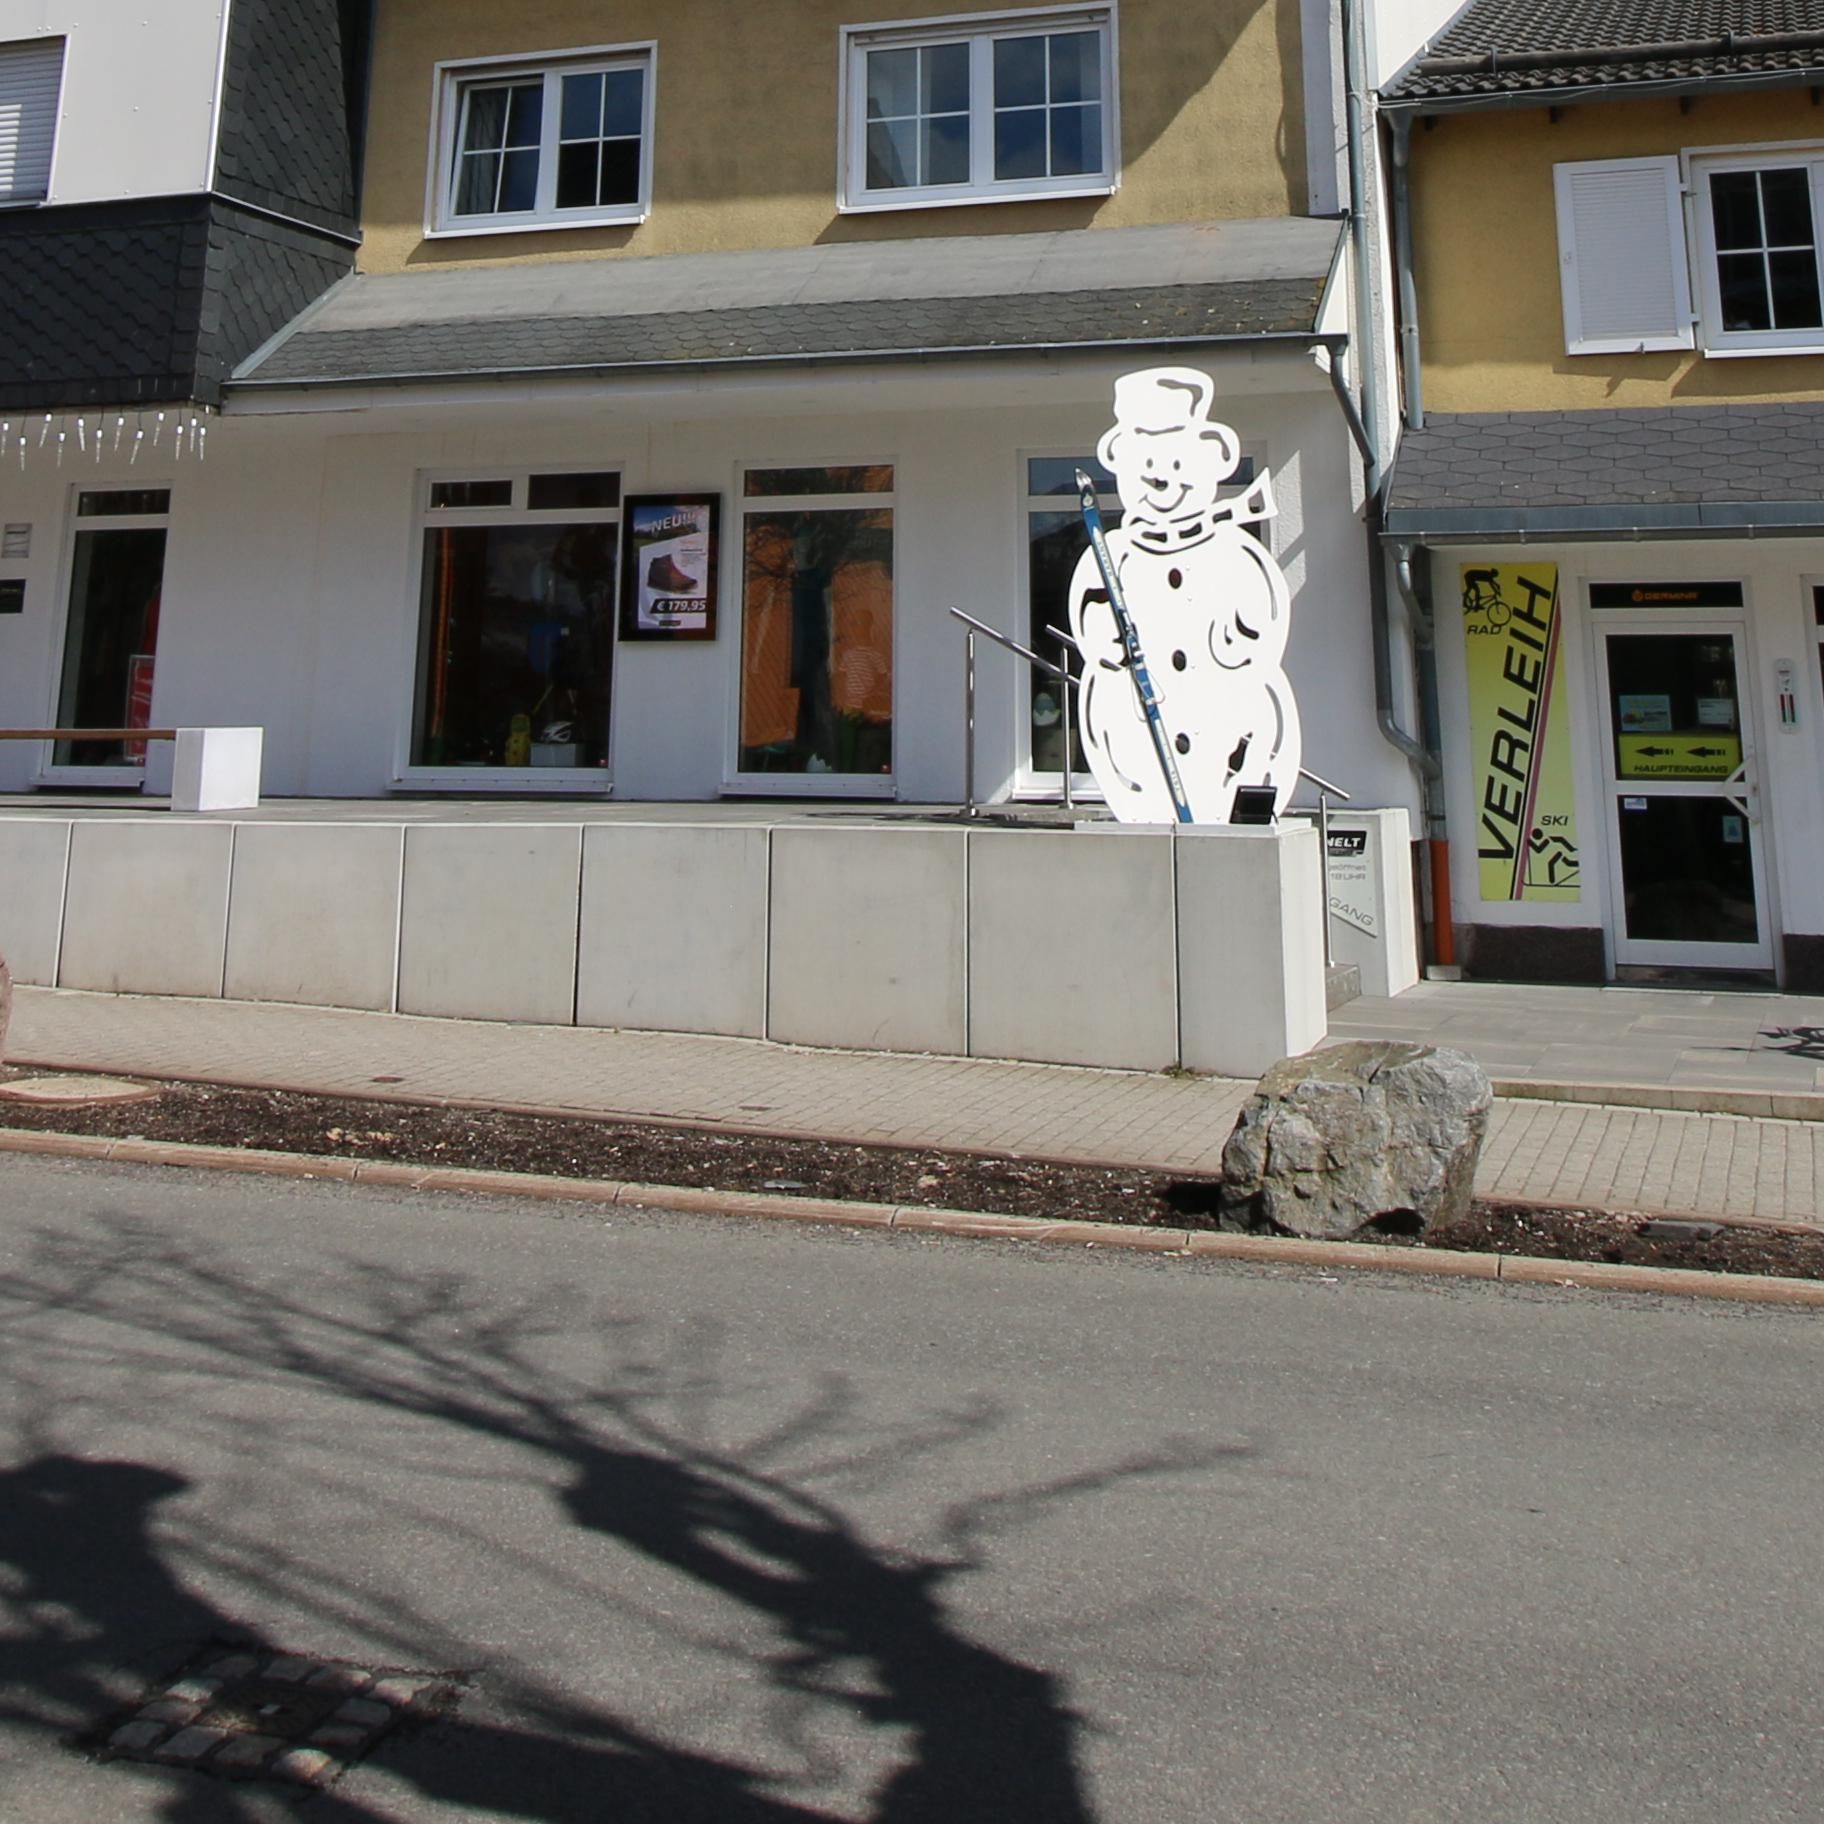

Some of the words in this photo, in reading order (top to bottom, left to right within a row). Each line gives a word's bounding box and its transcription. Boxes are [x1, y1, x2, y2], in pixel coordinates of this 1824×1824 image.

[1467, 624, 1502, 636] RAD
[1478, 575, 1553, 860] VERLEIH
[1633, 764, 1729, 774] HAUPTEINGANG
[1541, 815, 1569, 826] SKI
